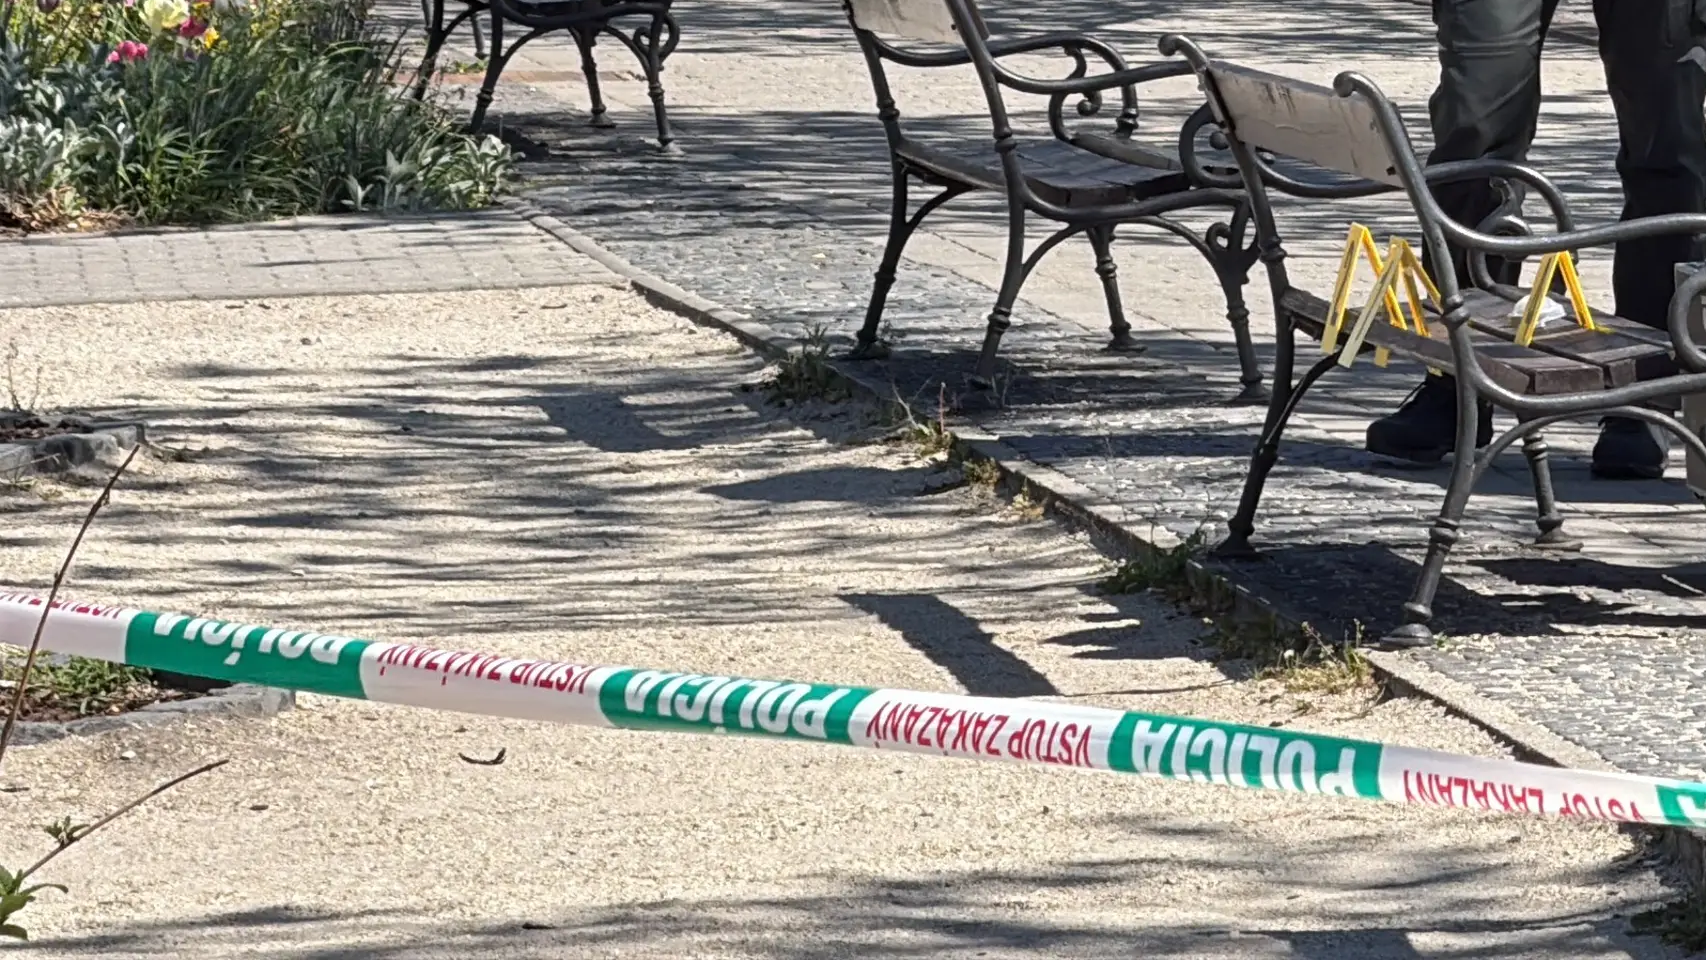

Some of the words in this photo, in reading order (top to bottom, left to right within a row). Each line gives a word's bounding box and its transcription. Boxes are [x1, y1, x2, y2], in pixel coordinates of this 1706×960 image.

[625, 670, 851, 738] POLÍCIA
[866, 700, 1009, 757] ZAKÁZANÝ
[1008, 716, 1092, 769] VSTUP
